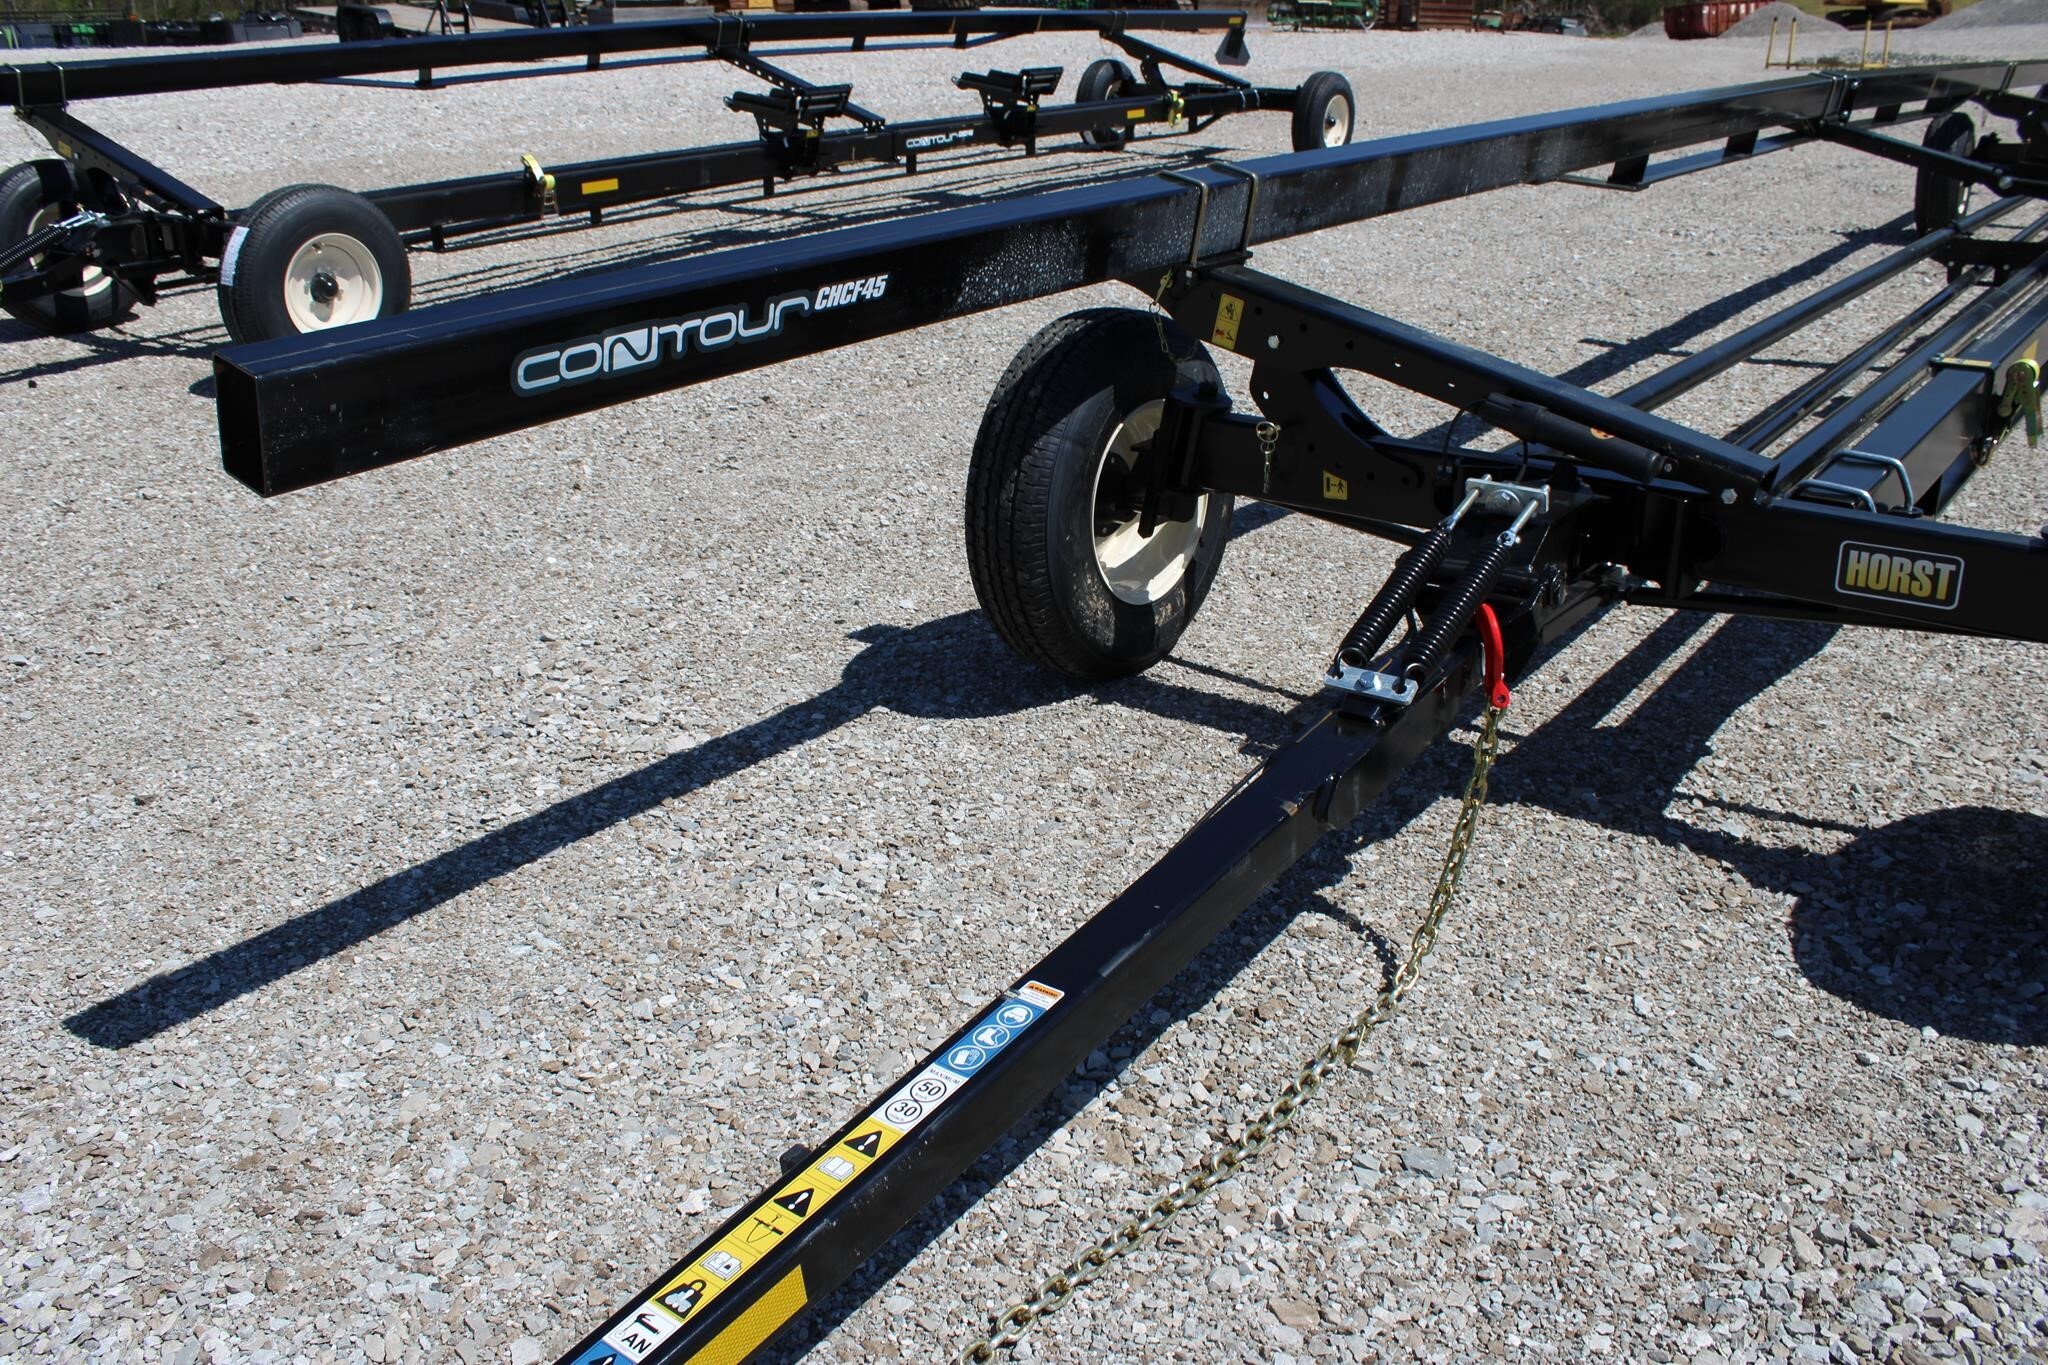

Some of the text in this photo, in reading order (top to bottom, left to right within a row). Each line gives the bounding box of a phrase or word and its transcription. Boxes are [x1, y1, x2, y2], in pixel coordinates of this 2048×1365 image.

[906, 131, 958, 148] CONTOUR
[516, 274, 889, 391] CONTOUR CHCF45
[1845, 549, 1957, 600] HORST
[929, 1067, 961, 1085] MAXIMUM
[918, 1081, 942, 1097] 50
[894, 1101, 918, 1117] 30
[620, 1332, 653, 1354] AN
